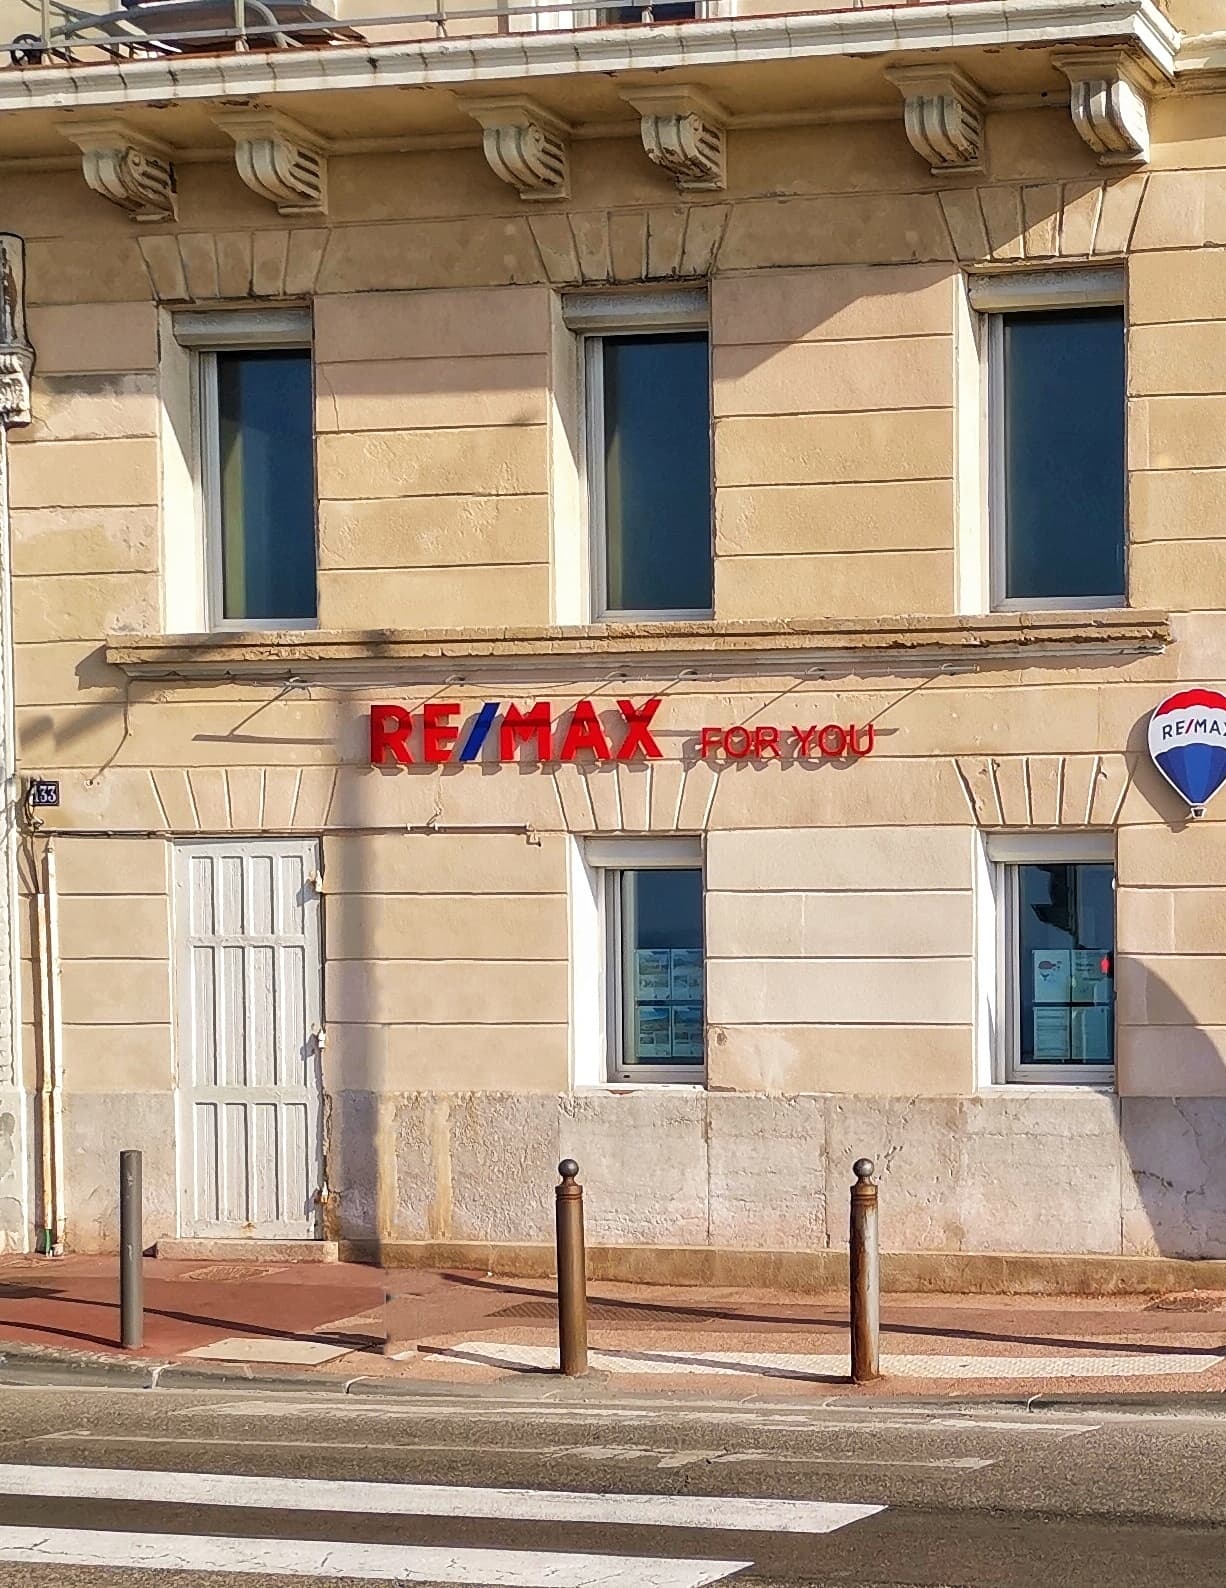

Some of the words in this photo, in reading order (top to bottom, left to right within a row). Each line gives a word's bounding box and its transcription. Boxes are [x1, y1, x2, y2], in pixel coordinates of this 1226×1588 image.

[370, 699, 664, 764] RE/MAX
[701, 724, 782, 759] FOR
[792, 724, 875, 758] YOU
[33, 785, 57, 803] 133
